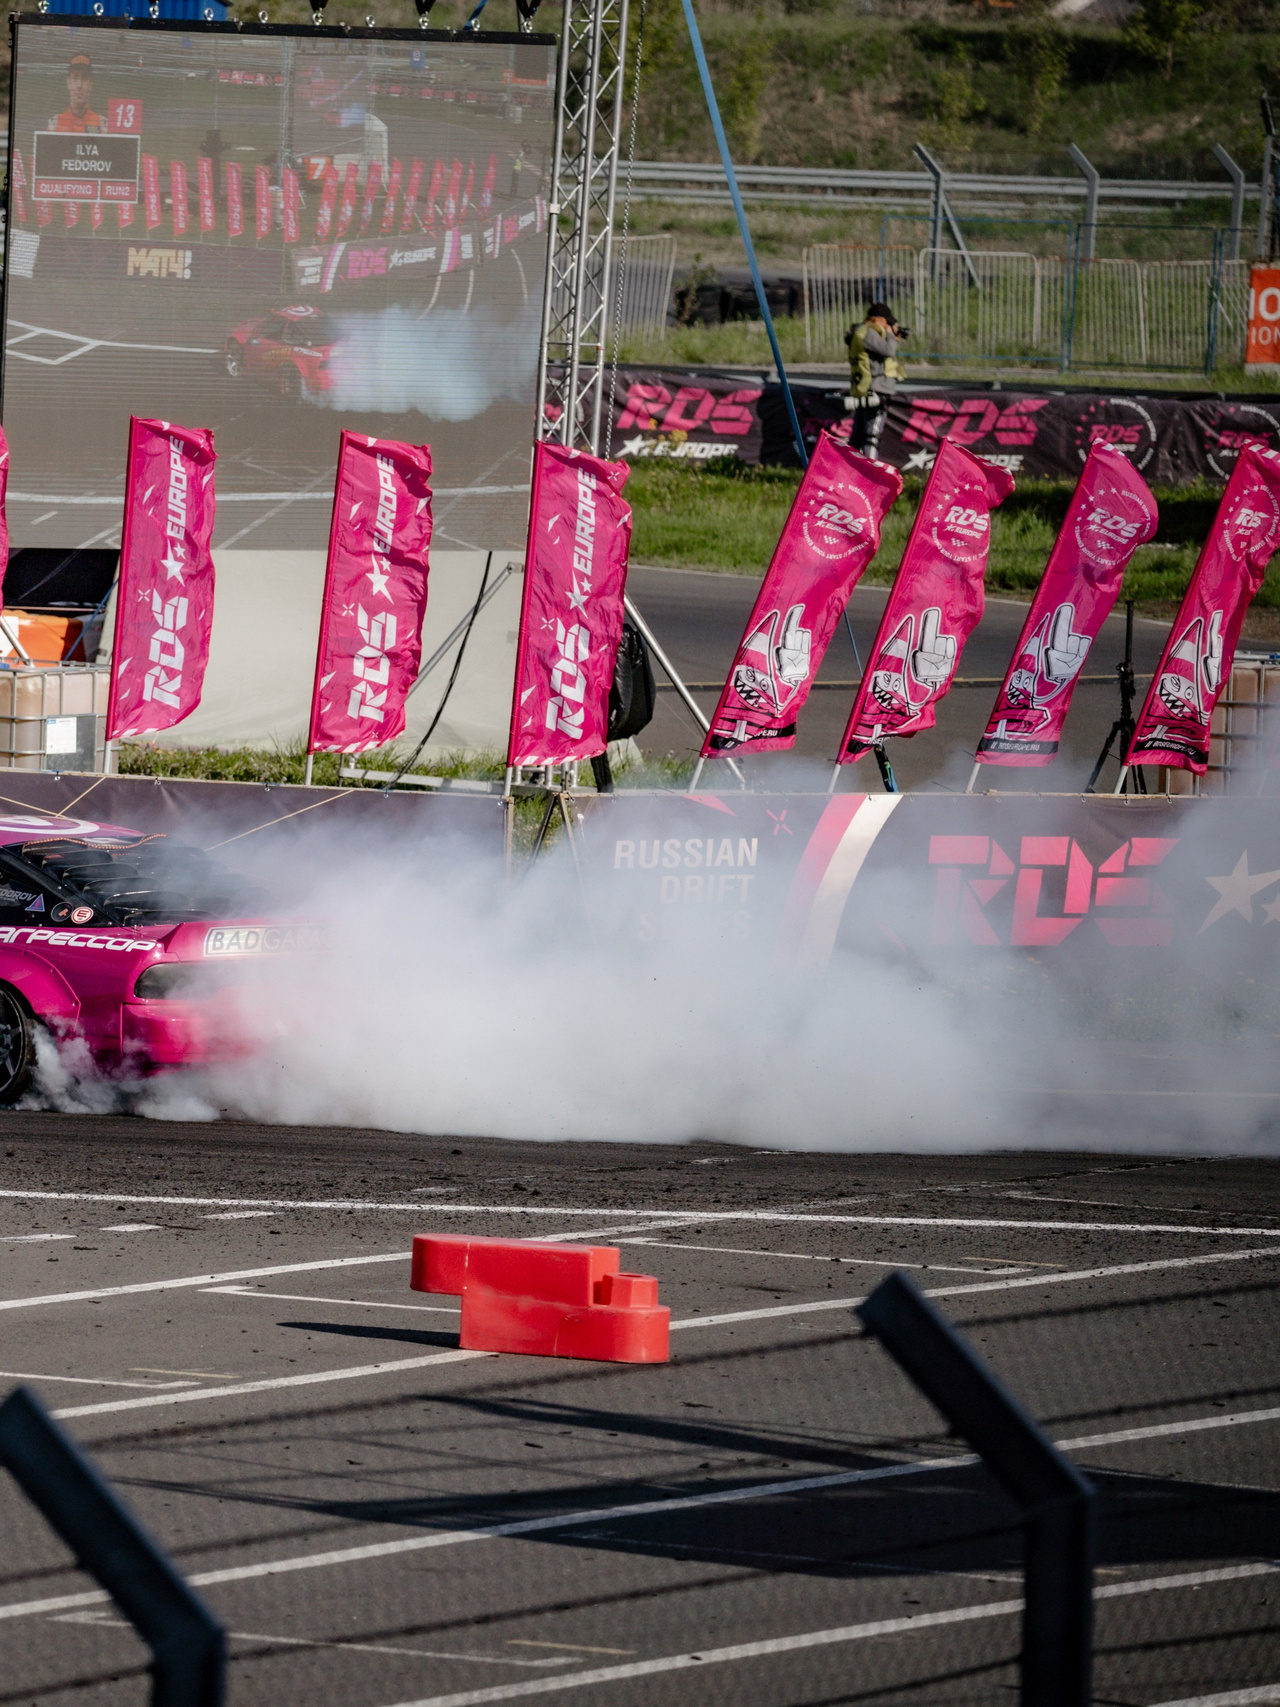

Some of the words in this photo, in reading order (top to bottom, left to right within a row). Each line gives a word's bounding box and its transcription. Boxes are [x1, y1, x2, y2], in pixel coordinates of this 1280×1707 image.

[116, 104, 135, 128] 13
[76, 144, 99, 156] ILYA
[61, 159, 112, 173] FEDOROV
[40, 184, 93, 195] QUALIFYING
[105, 185, 131, 196] RUN2
[617, 384, 762, 435] RDS
[901, 399, 1050, 445] RDS
[1089, 424, 1144, 444] RDS
[166, 435, 188, 540] EUROPE
[1121, 490, 1143, 506] RUSSIAN
[815, 503, 868, 534] RDS
[825, 522, 856, 538] EUROPE
[945, 505, 990, 532] RDS
[1087, 508, 1143, 538] RDS
[955, 526, 983, 539] EUROPE
[1099, 528, 1129, 545] EUROPE
[347, 603, 397, 723] RDS
[372, 453, 396, 556] EUROPE
[546, 618, 590, 740] RDS
[572, 467, 597, 576] EUROPE
[144, 588, 189, 710] RDS
[614, 838, 758, 869] RUSSIAN
[660, 874, 755, 905] DRIFT
[929, 835, 1181, 946] RDS
[212, 928, 260, 951] BAD
